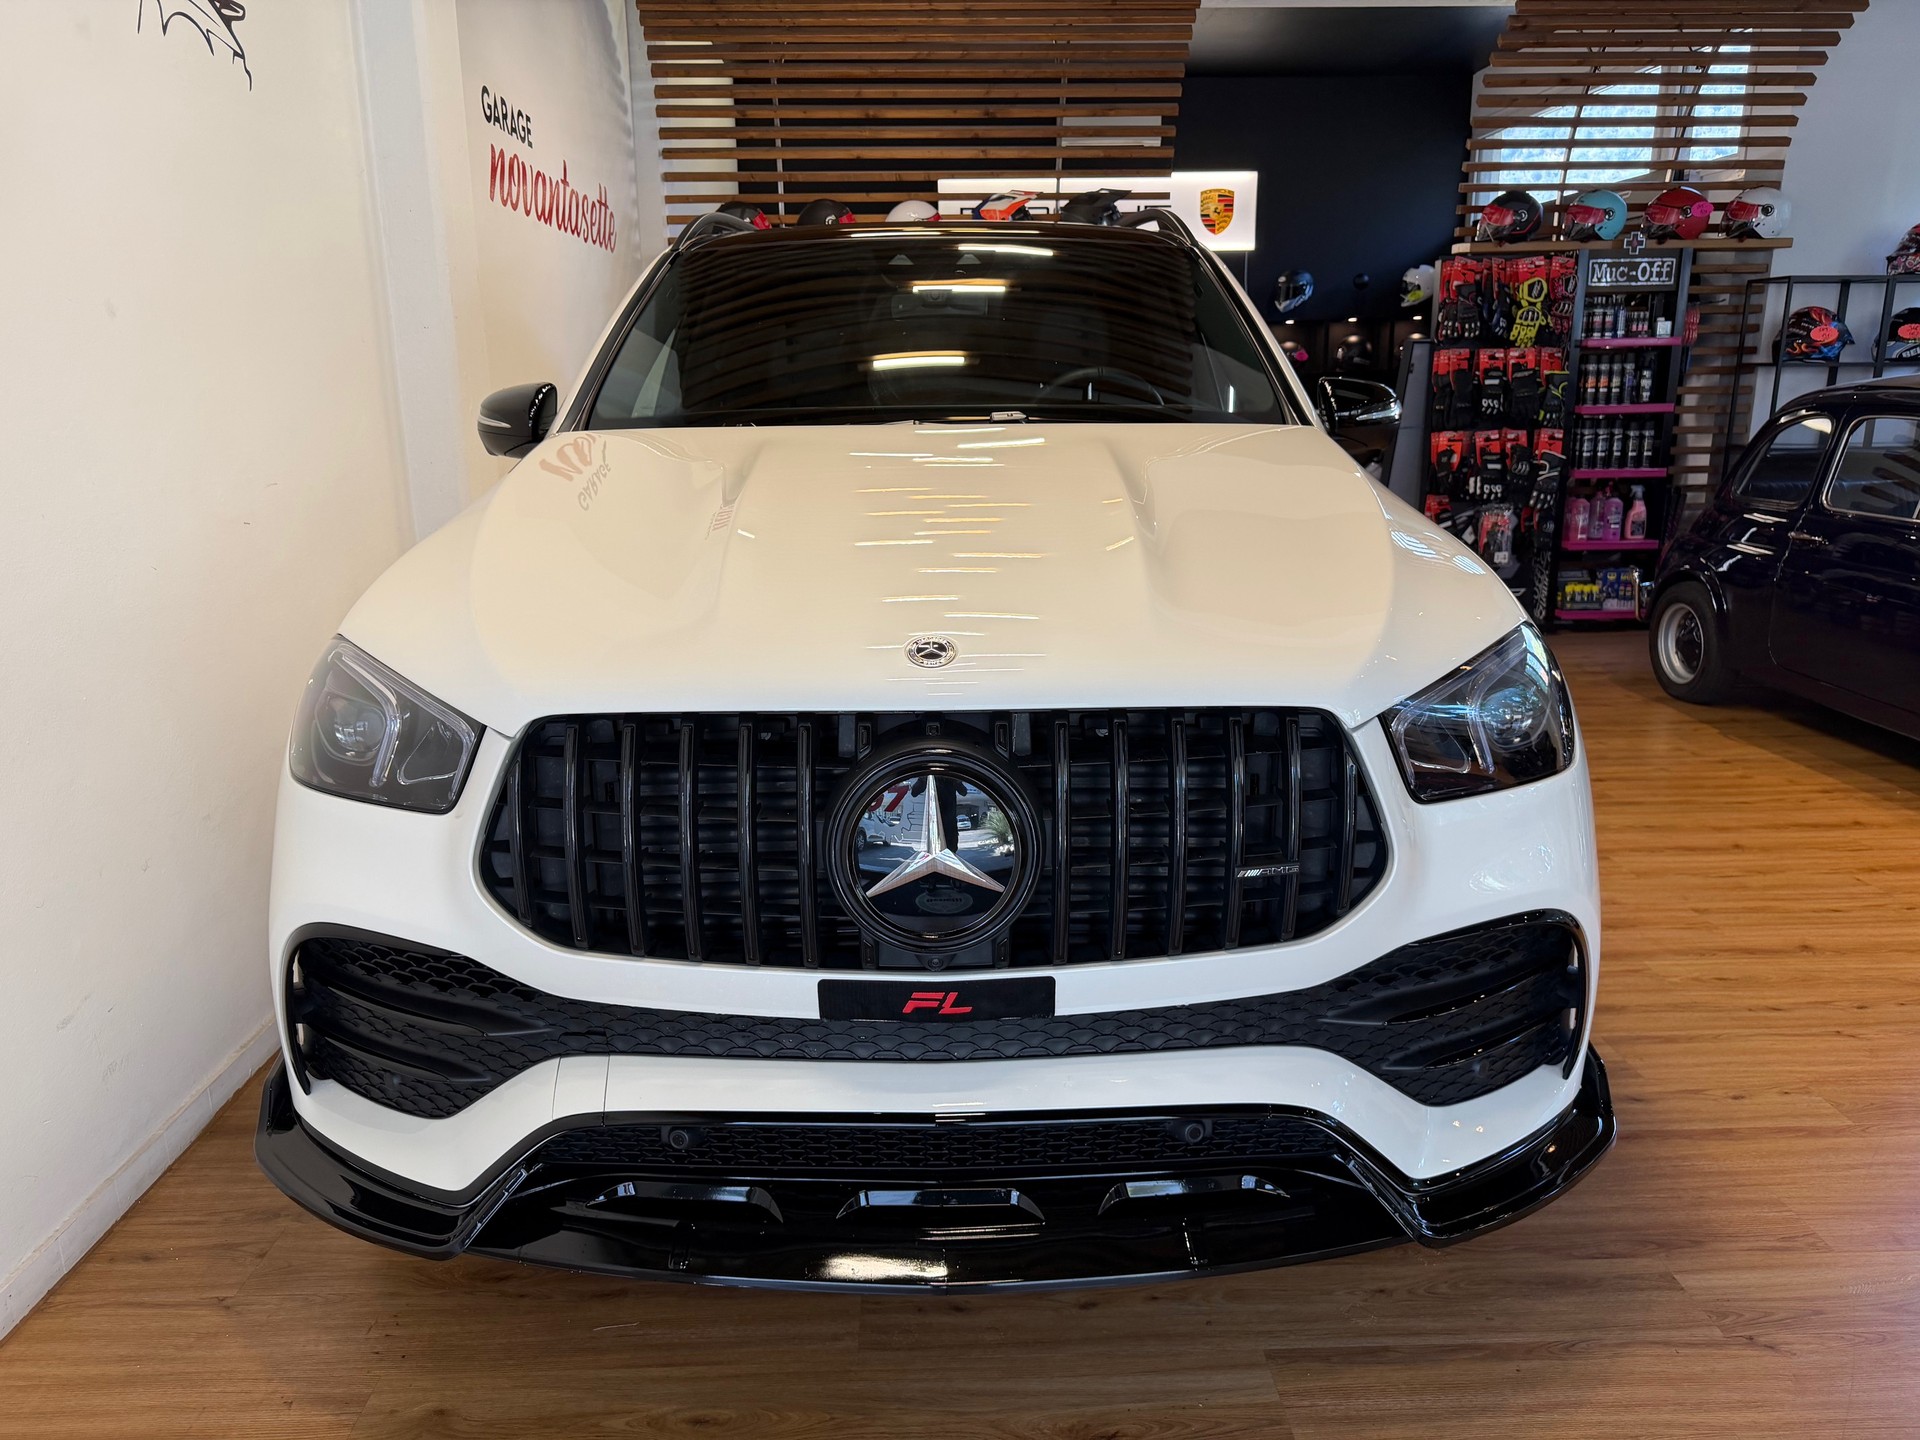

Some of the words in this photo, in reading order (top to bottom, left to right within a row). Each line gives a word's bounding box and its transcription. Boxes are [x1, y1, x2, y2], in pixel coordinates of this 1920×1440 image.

[482, 86, 533, 149] GARAGE
[490, 143, 617, 253] novantasette
[1592, 261, 1673, 282] Muc-Off
[901, 991, 973, 1015] FL
